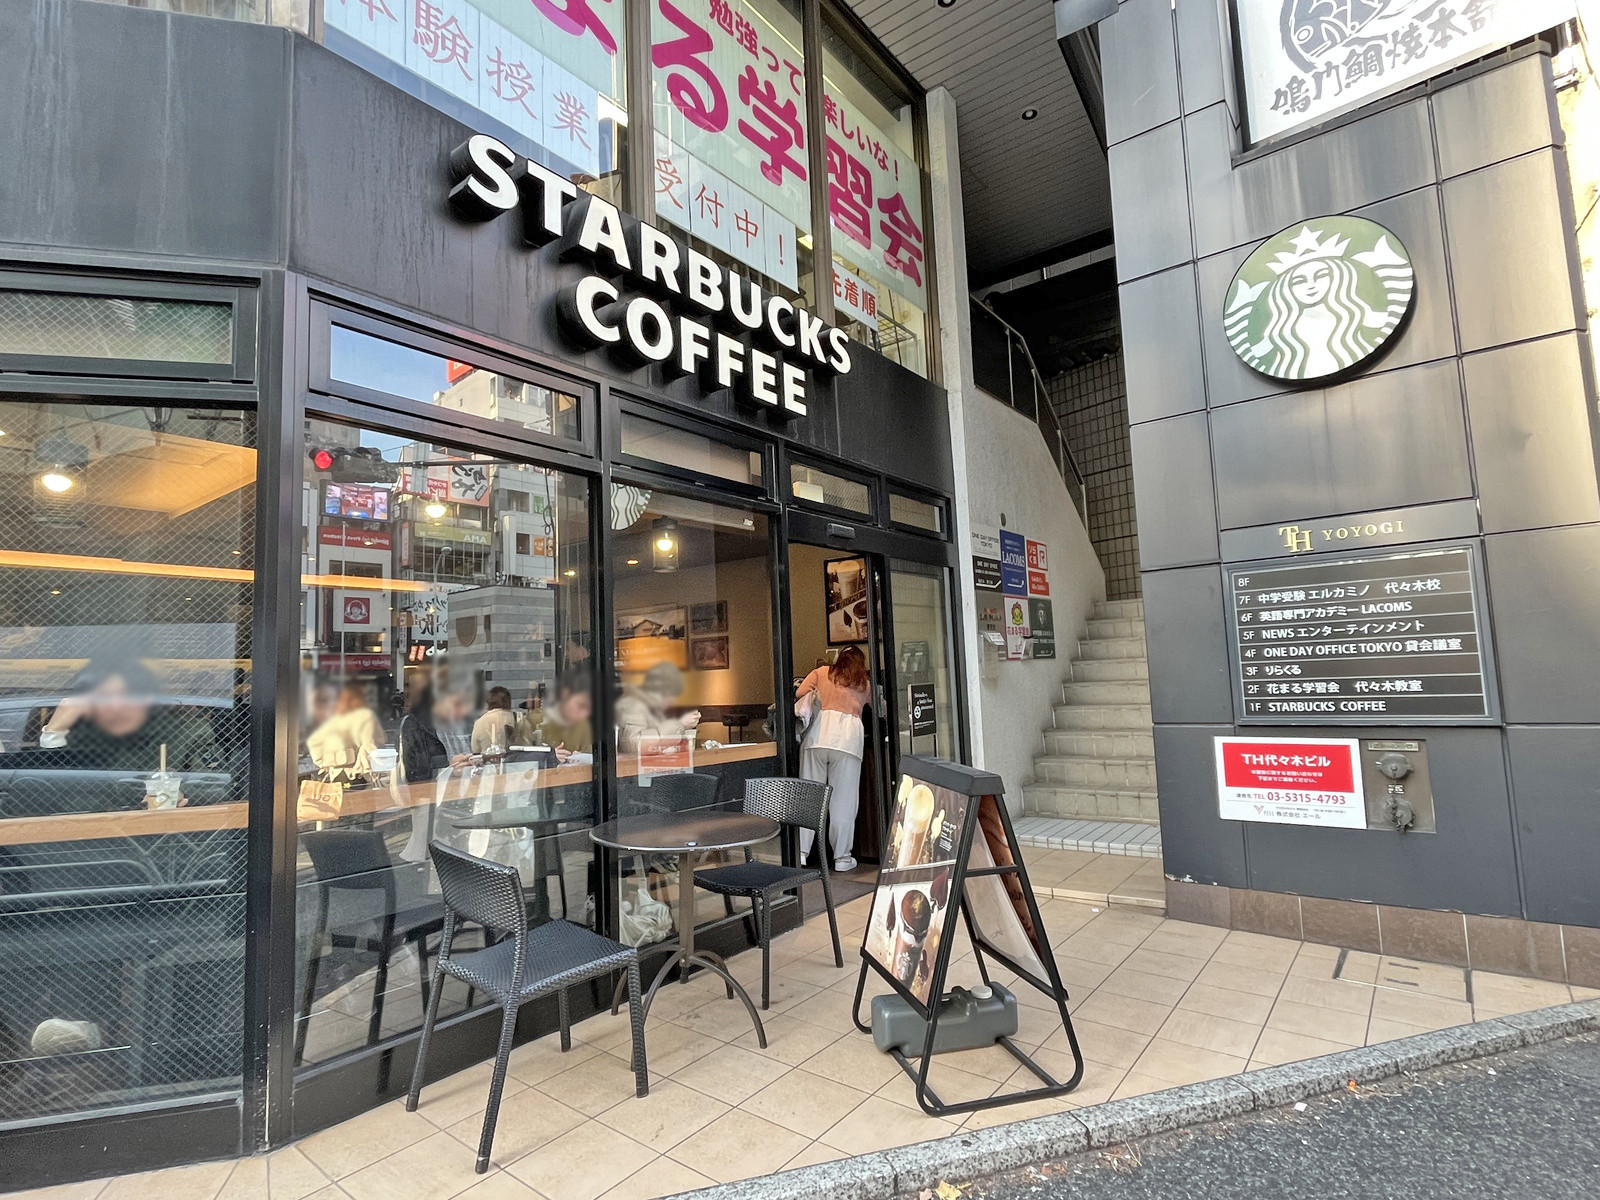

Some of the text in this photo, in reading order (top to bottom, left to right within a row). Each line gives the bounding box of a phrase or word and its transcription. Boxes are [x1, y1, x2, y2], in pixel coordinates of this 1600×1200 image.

[467, 133, 853, 375] STARBUCKS
[576, 275, 808, 416] COFFEE
[1279, 520, 1404, 553] TH YOYOGI
[1002, 551, 1025, 567] LACOMS
[1238, 577, 1250, 587] 8F
[1239, 578, 1441, 605] 7F 中学受験 エルカミノ 代々木校
[1241, 601, 1413, 622] 6F 英語専門アカデミー LACOMS
[1243, 620, 1425, 640] 5F NEWS エンターテインメント
[1245, 638, 1462, 658] 4F ONE DAY OFFICE TOKYO 貸会議室
[1246, 664, 1302, 676] 3F りらくる
[1247, 680, 1423, 695] 2F 花まる学習会 代々木教室
[1250, 701, 1386, 713] 1F STARBUCKS COFFEE
[1241, 753, 1331, 767] TH代々木ビル
[1254, 793, 1265, 801] TEL
[1267, 791, 1346, 805] 03-5315-4793
[1277, 811, 1301, 819] 株式会社
